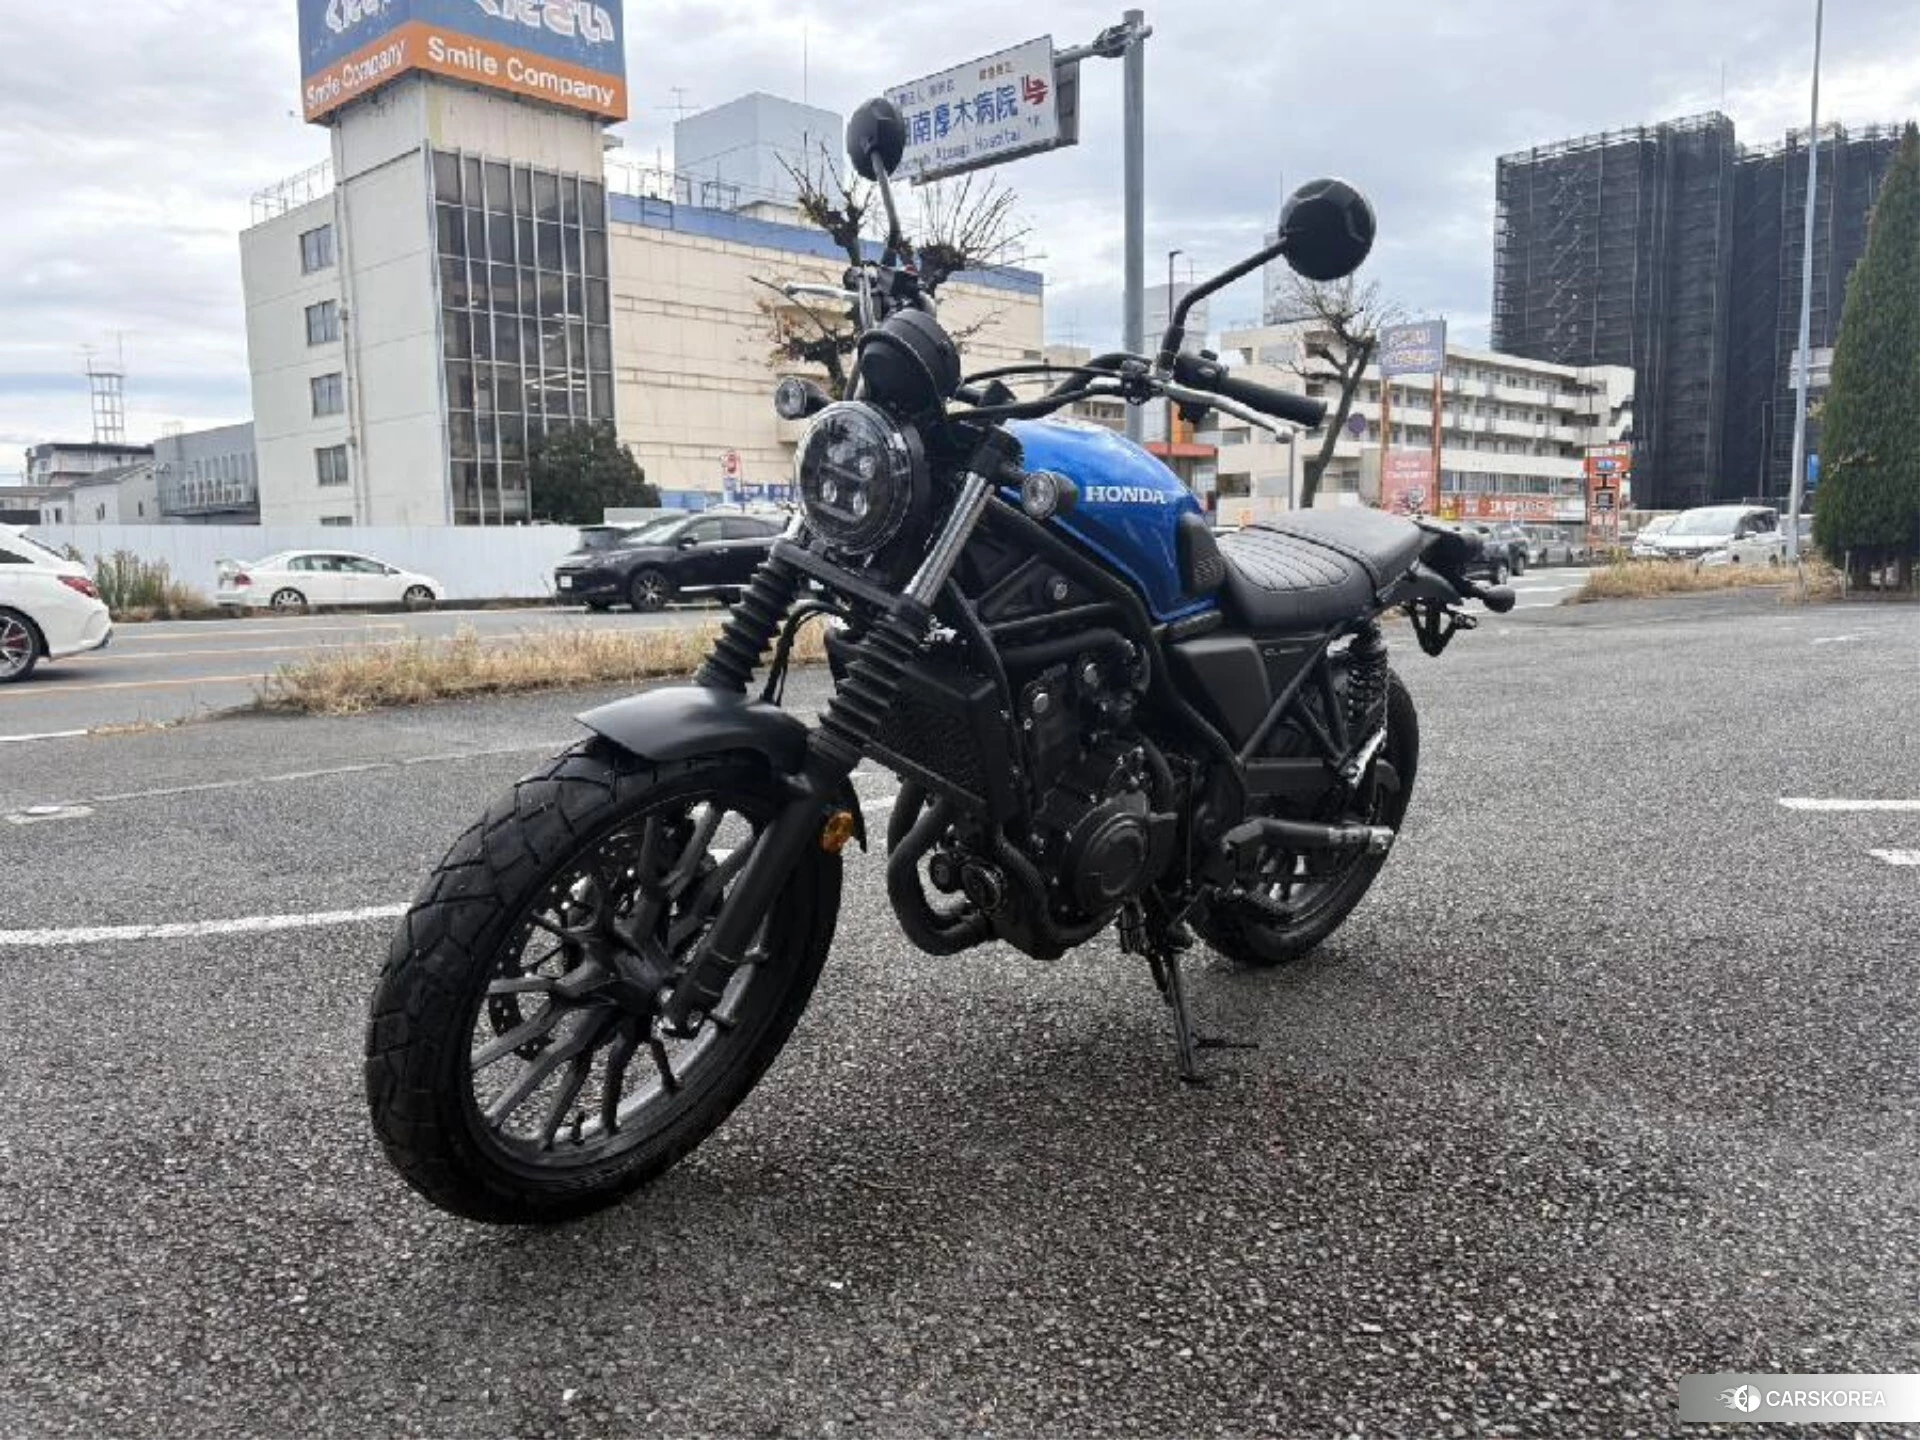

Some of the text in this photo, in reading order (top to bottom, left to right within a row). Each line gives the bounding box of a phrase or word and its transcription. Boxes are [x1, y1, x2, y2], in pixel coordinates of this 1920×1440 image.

[427, 36, 616, 107] Smile Company
[1085, 486, 1167, 504] HONDA
